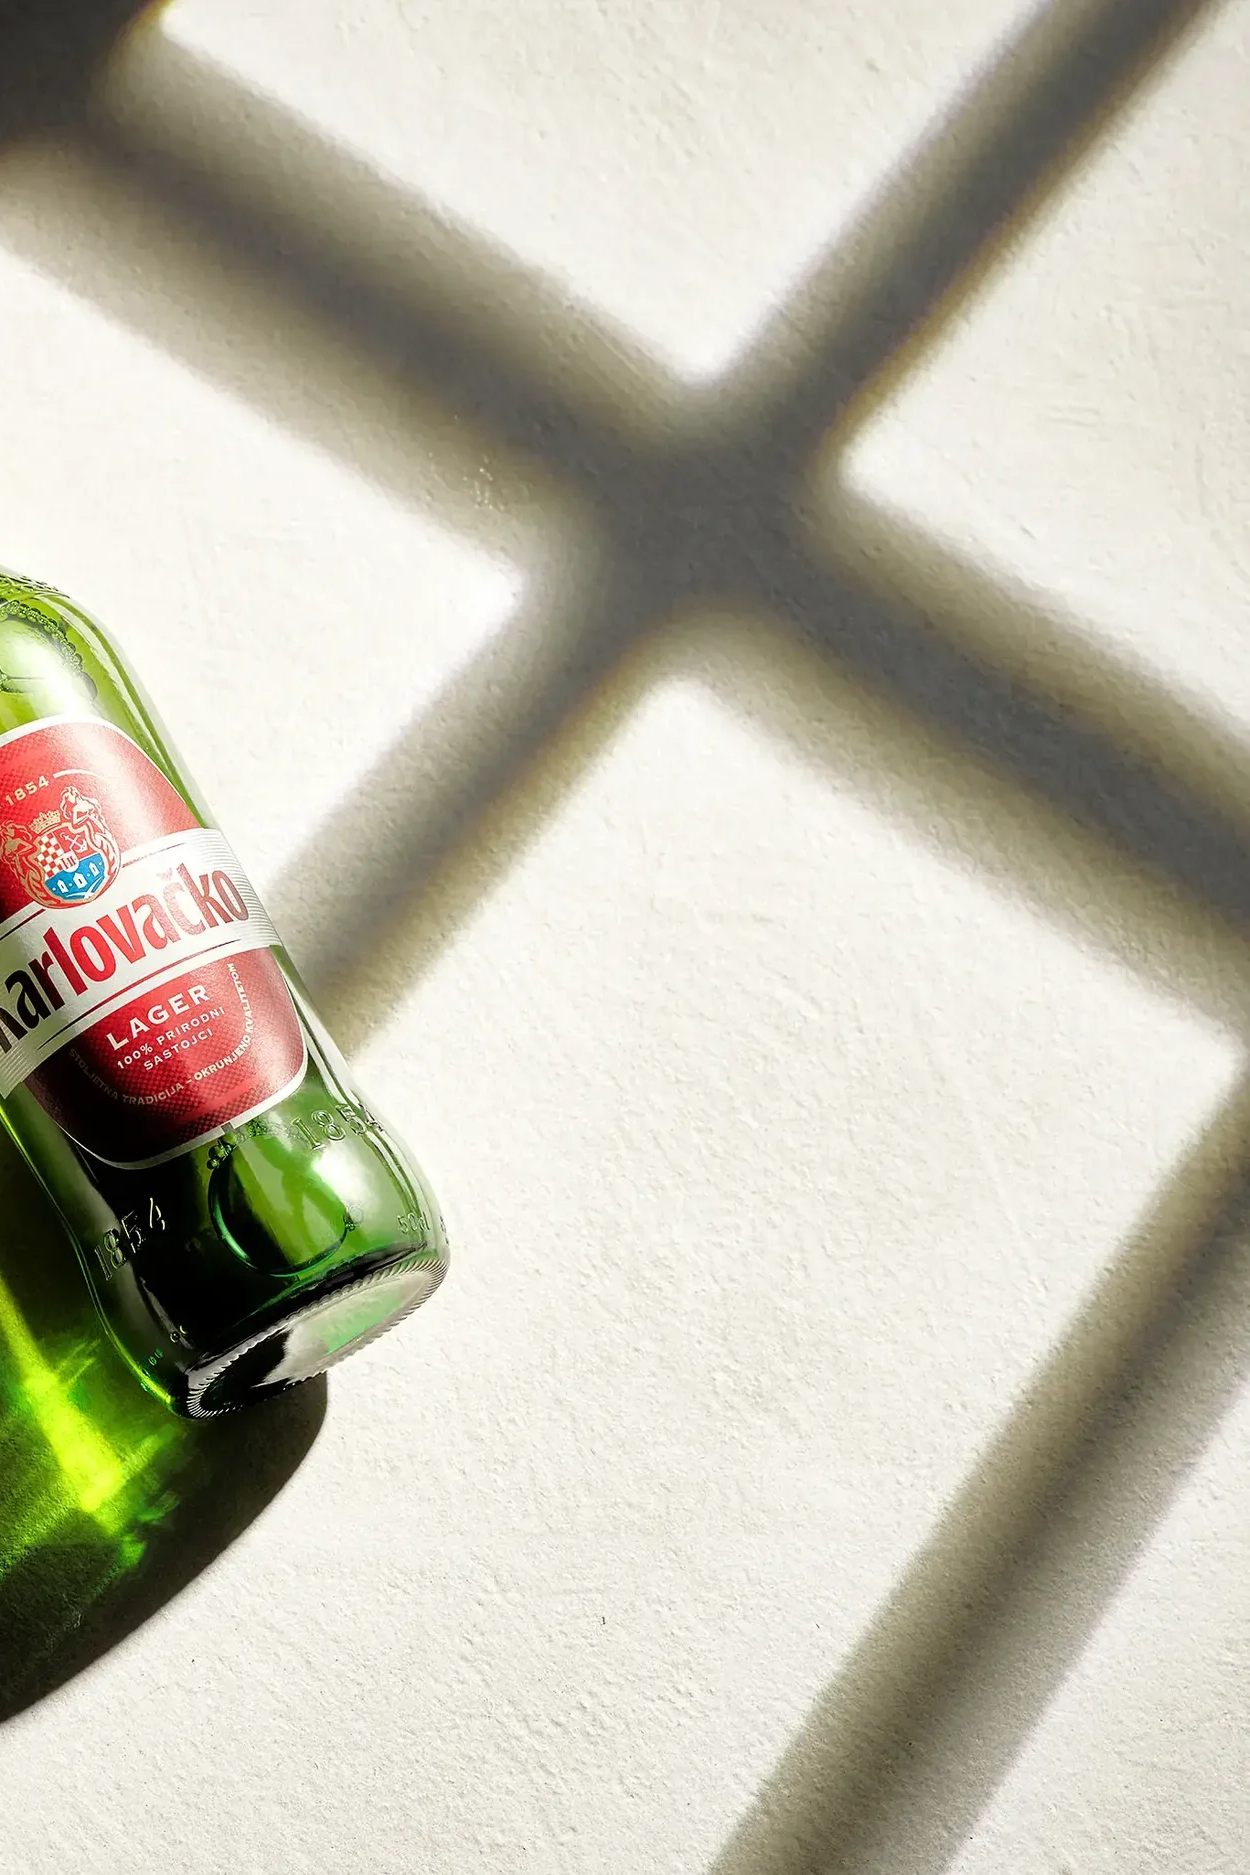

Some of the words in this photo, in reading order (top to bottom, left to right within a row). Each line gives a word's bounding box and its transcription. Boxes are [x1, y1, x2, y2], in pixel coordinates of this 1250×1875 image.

[5, 775, 49, 805] 1854
[69, 1048, 118, 1100] STOLJETNA
[122, 1082, 185, 1105] TRADICIJA
[193, 1035, 251, 1081] OKRUNJENO
[226, 963, 254, 1034] KVALITETOM
[106, 985, 210, 1051] LAGER
[117, 1043, 153, 1069] 100%
[156, 1006, 226, 1046] PRIRODNI
[143, 1028, 213, 1071] SASTOJCI
